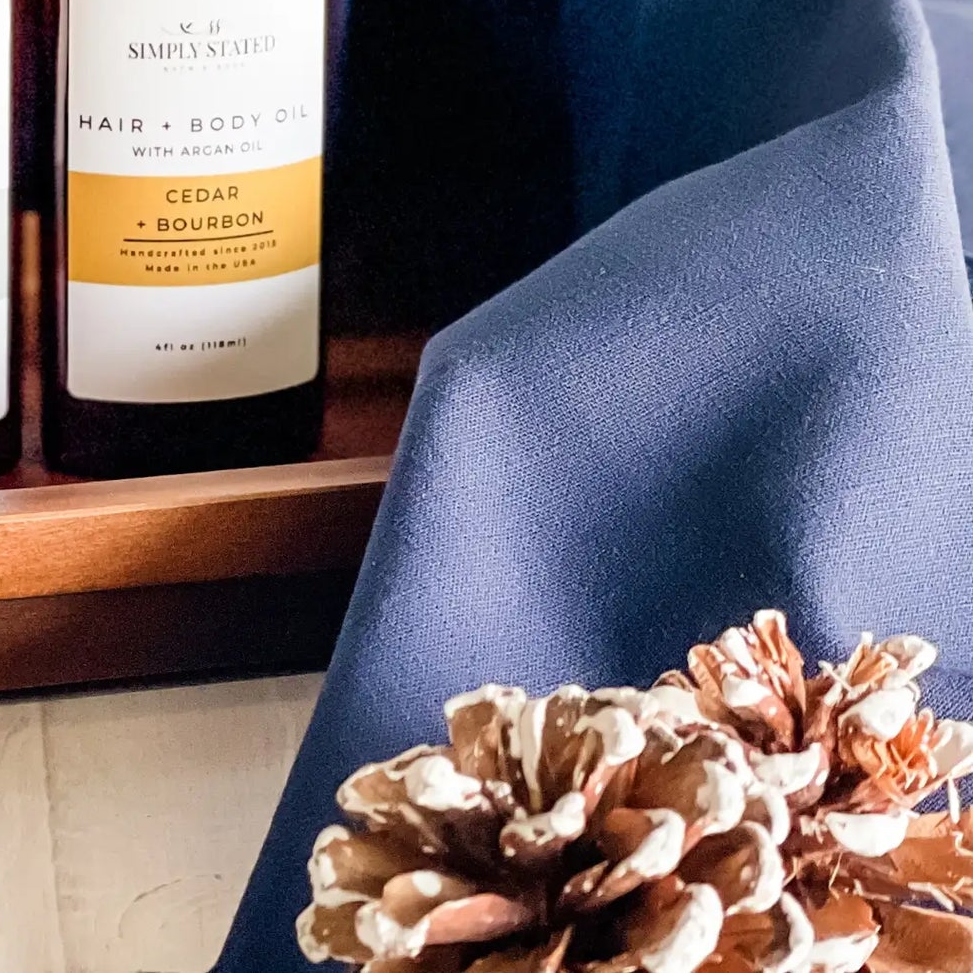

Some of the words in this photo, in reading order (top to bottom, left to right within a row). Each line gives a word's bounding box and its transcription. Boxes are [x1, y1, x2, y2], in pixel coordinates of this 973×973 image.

[128, 43, 201, 59] SIMPLY
[206, 36, 275, 57] STATED
[79, 115, 143, 133] HAIR
[161, 121, 172, 131] +
[191, 114, 260, 132] BODY
[275, 104, 308, 123] OIL
[131, 146, 174, 158] WITH
[179, 143, 234, 157] ARGAN
[239, 139, 264, 154] OIL
[166, 186, 238, 204] CEDAR
[136, 220, 147, 229] +
[157, 211, 264, 232] BOURBON
[119, 247, 206, 259] Handcrafted
[212, 245, 247, 256] since
[144, 264, 180, 273] Made
[186, 263, 199, 272] in
[205, 262, 228, 272] the
[155, 342, 174, 352] 4fl
[179, 343, 195, 351] oz
